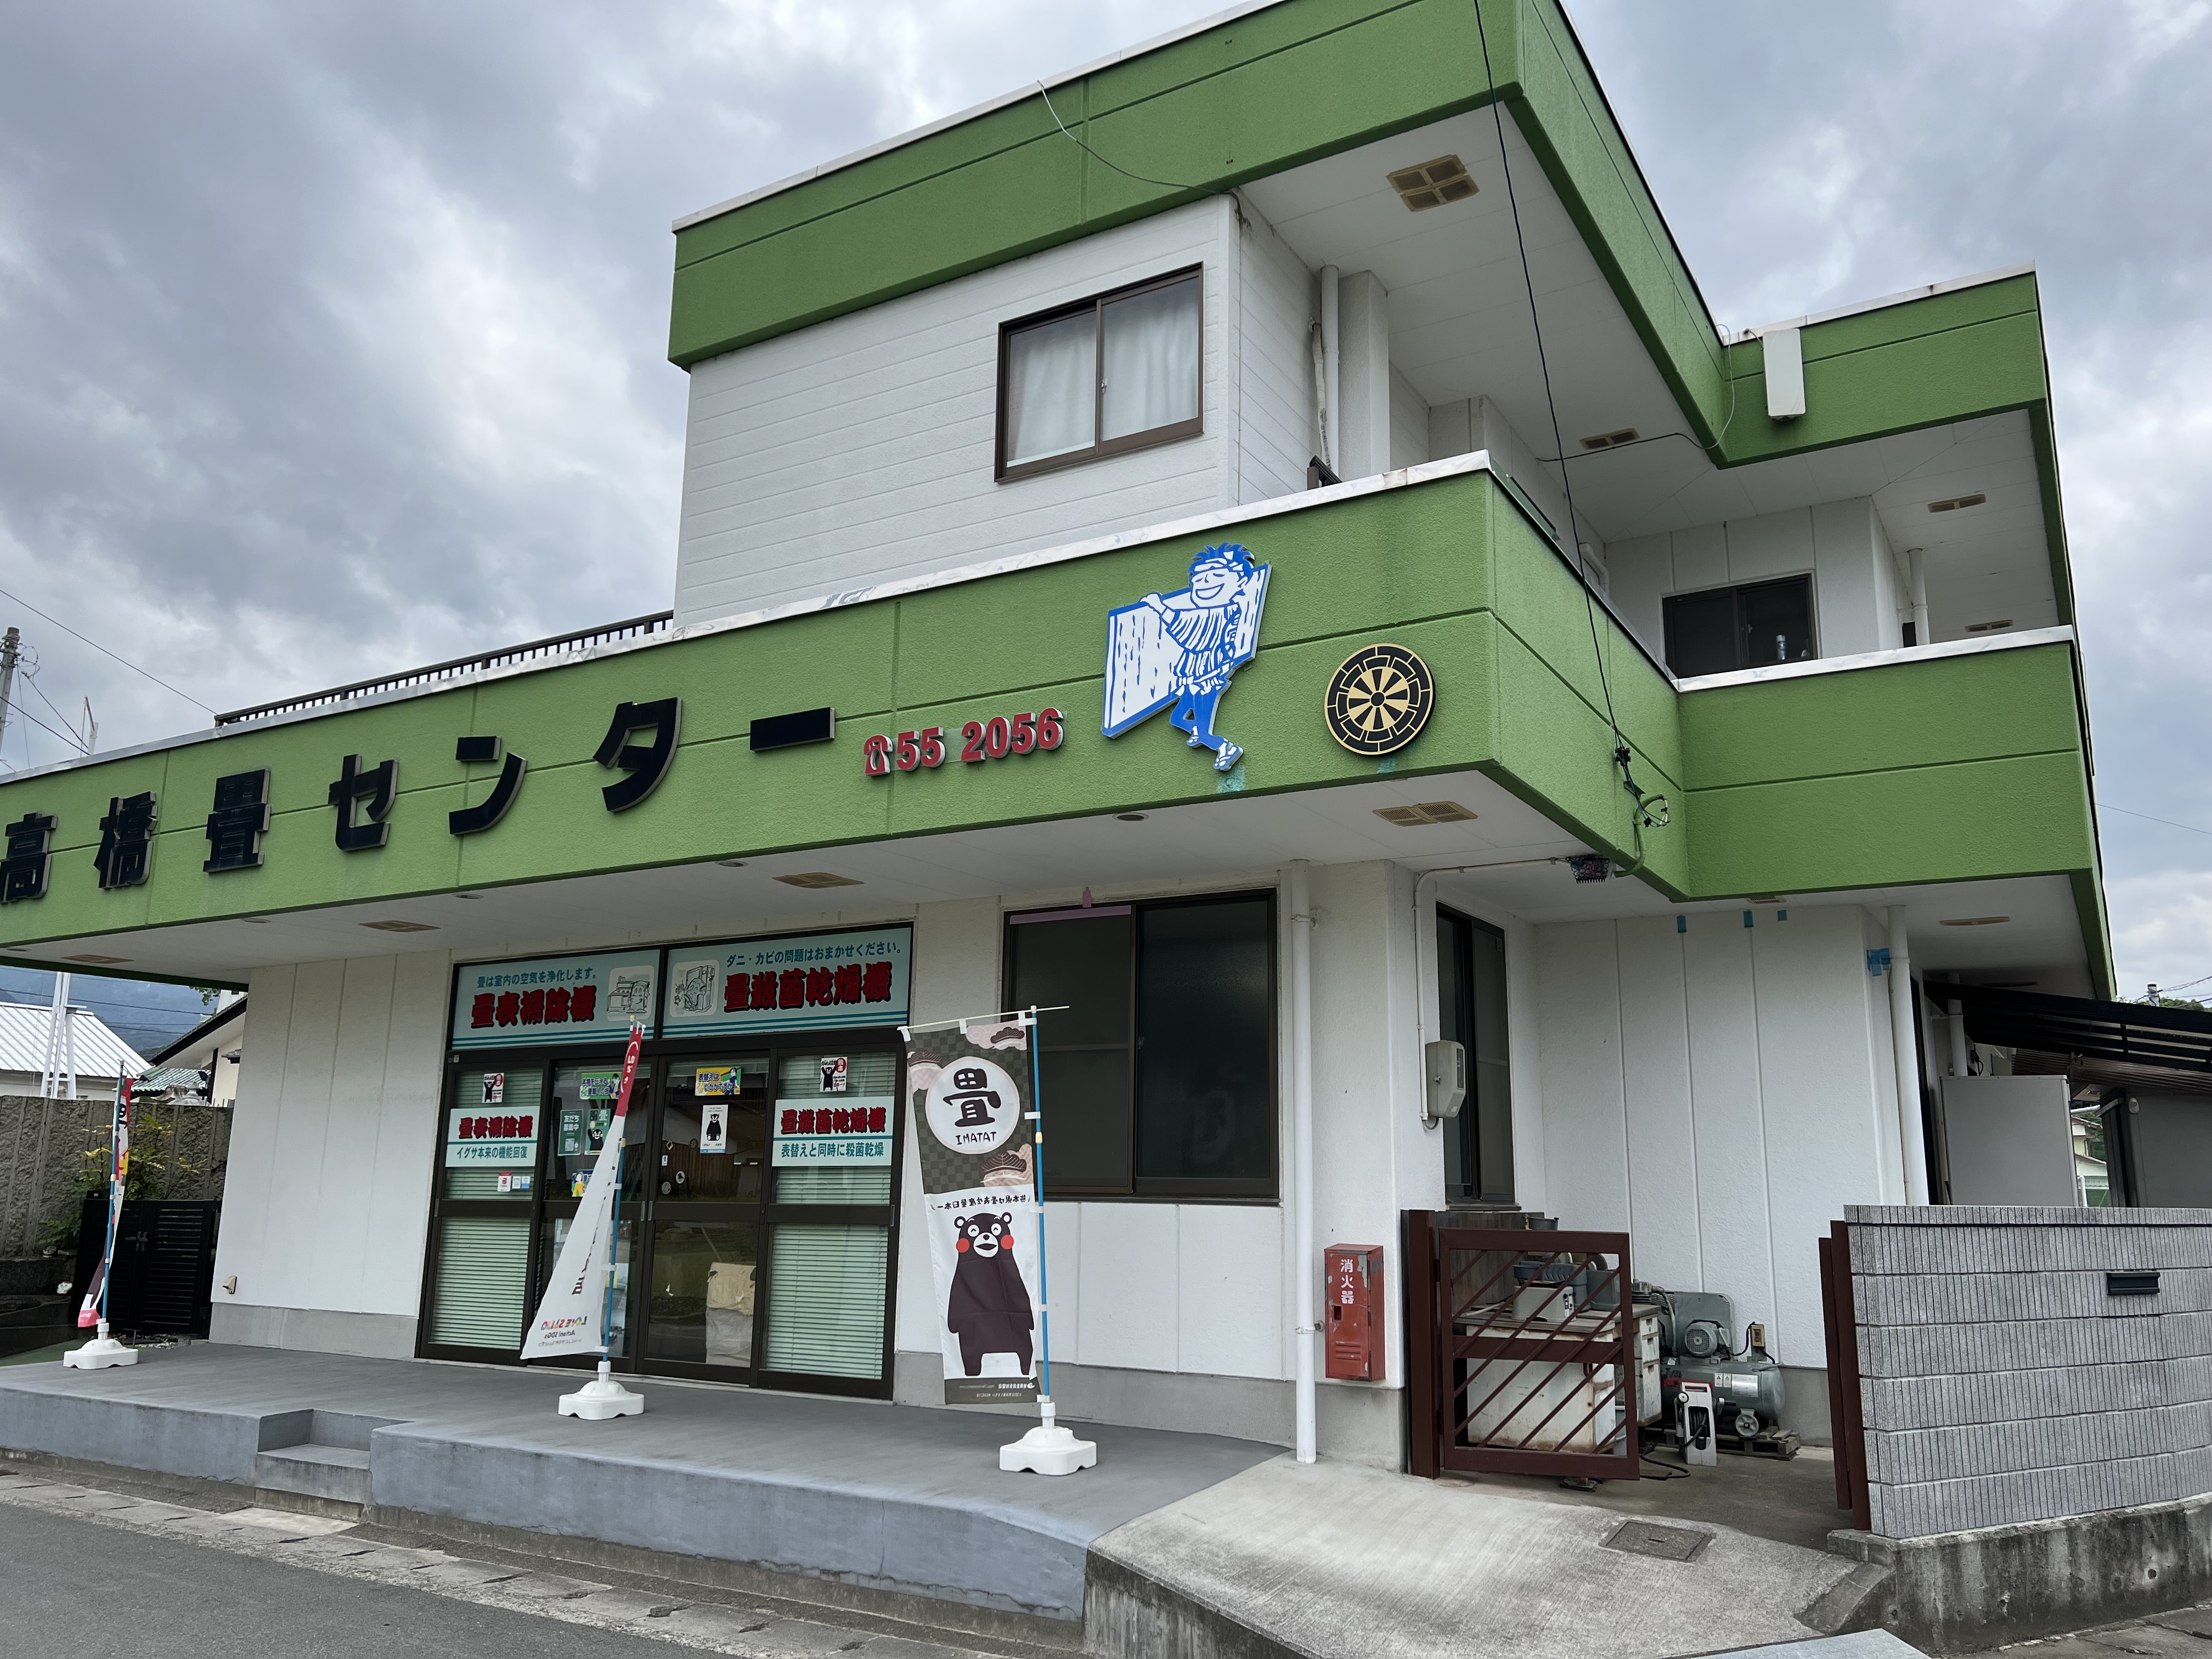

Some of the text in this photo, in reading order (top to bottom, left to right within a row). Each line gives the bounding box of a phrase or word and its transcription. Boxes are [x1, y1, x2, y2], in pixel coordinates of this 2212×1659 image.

[895, 707, 1065, 772] 55 2056
[0, 696, 835, 904] 高橋畳センター
[726, 941, 901, 968] ダニ・カビの問題はおまかせください。
[477, 967, 596, 988] 畳は室内の空気を浄化します。
[724, 961, 893, 1013] 畳殺菌乾燥機
[471, 985, 597, 1029] 畳表掃除機
[457, 1146, 528, 1159] イグサ本来の機能回復
[781, 1142, 884, 1158] 表替えと同時に殺菌乾燥
[1340, 1258, 1355, 1305] 消火器
